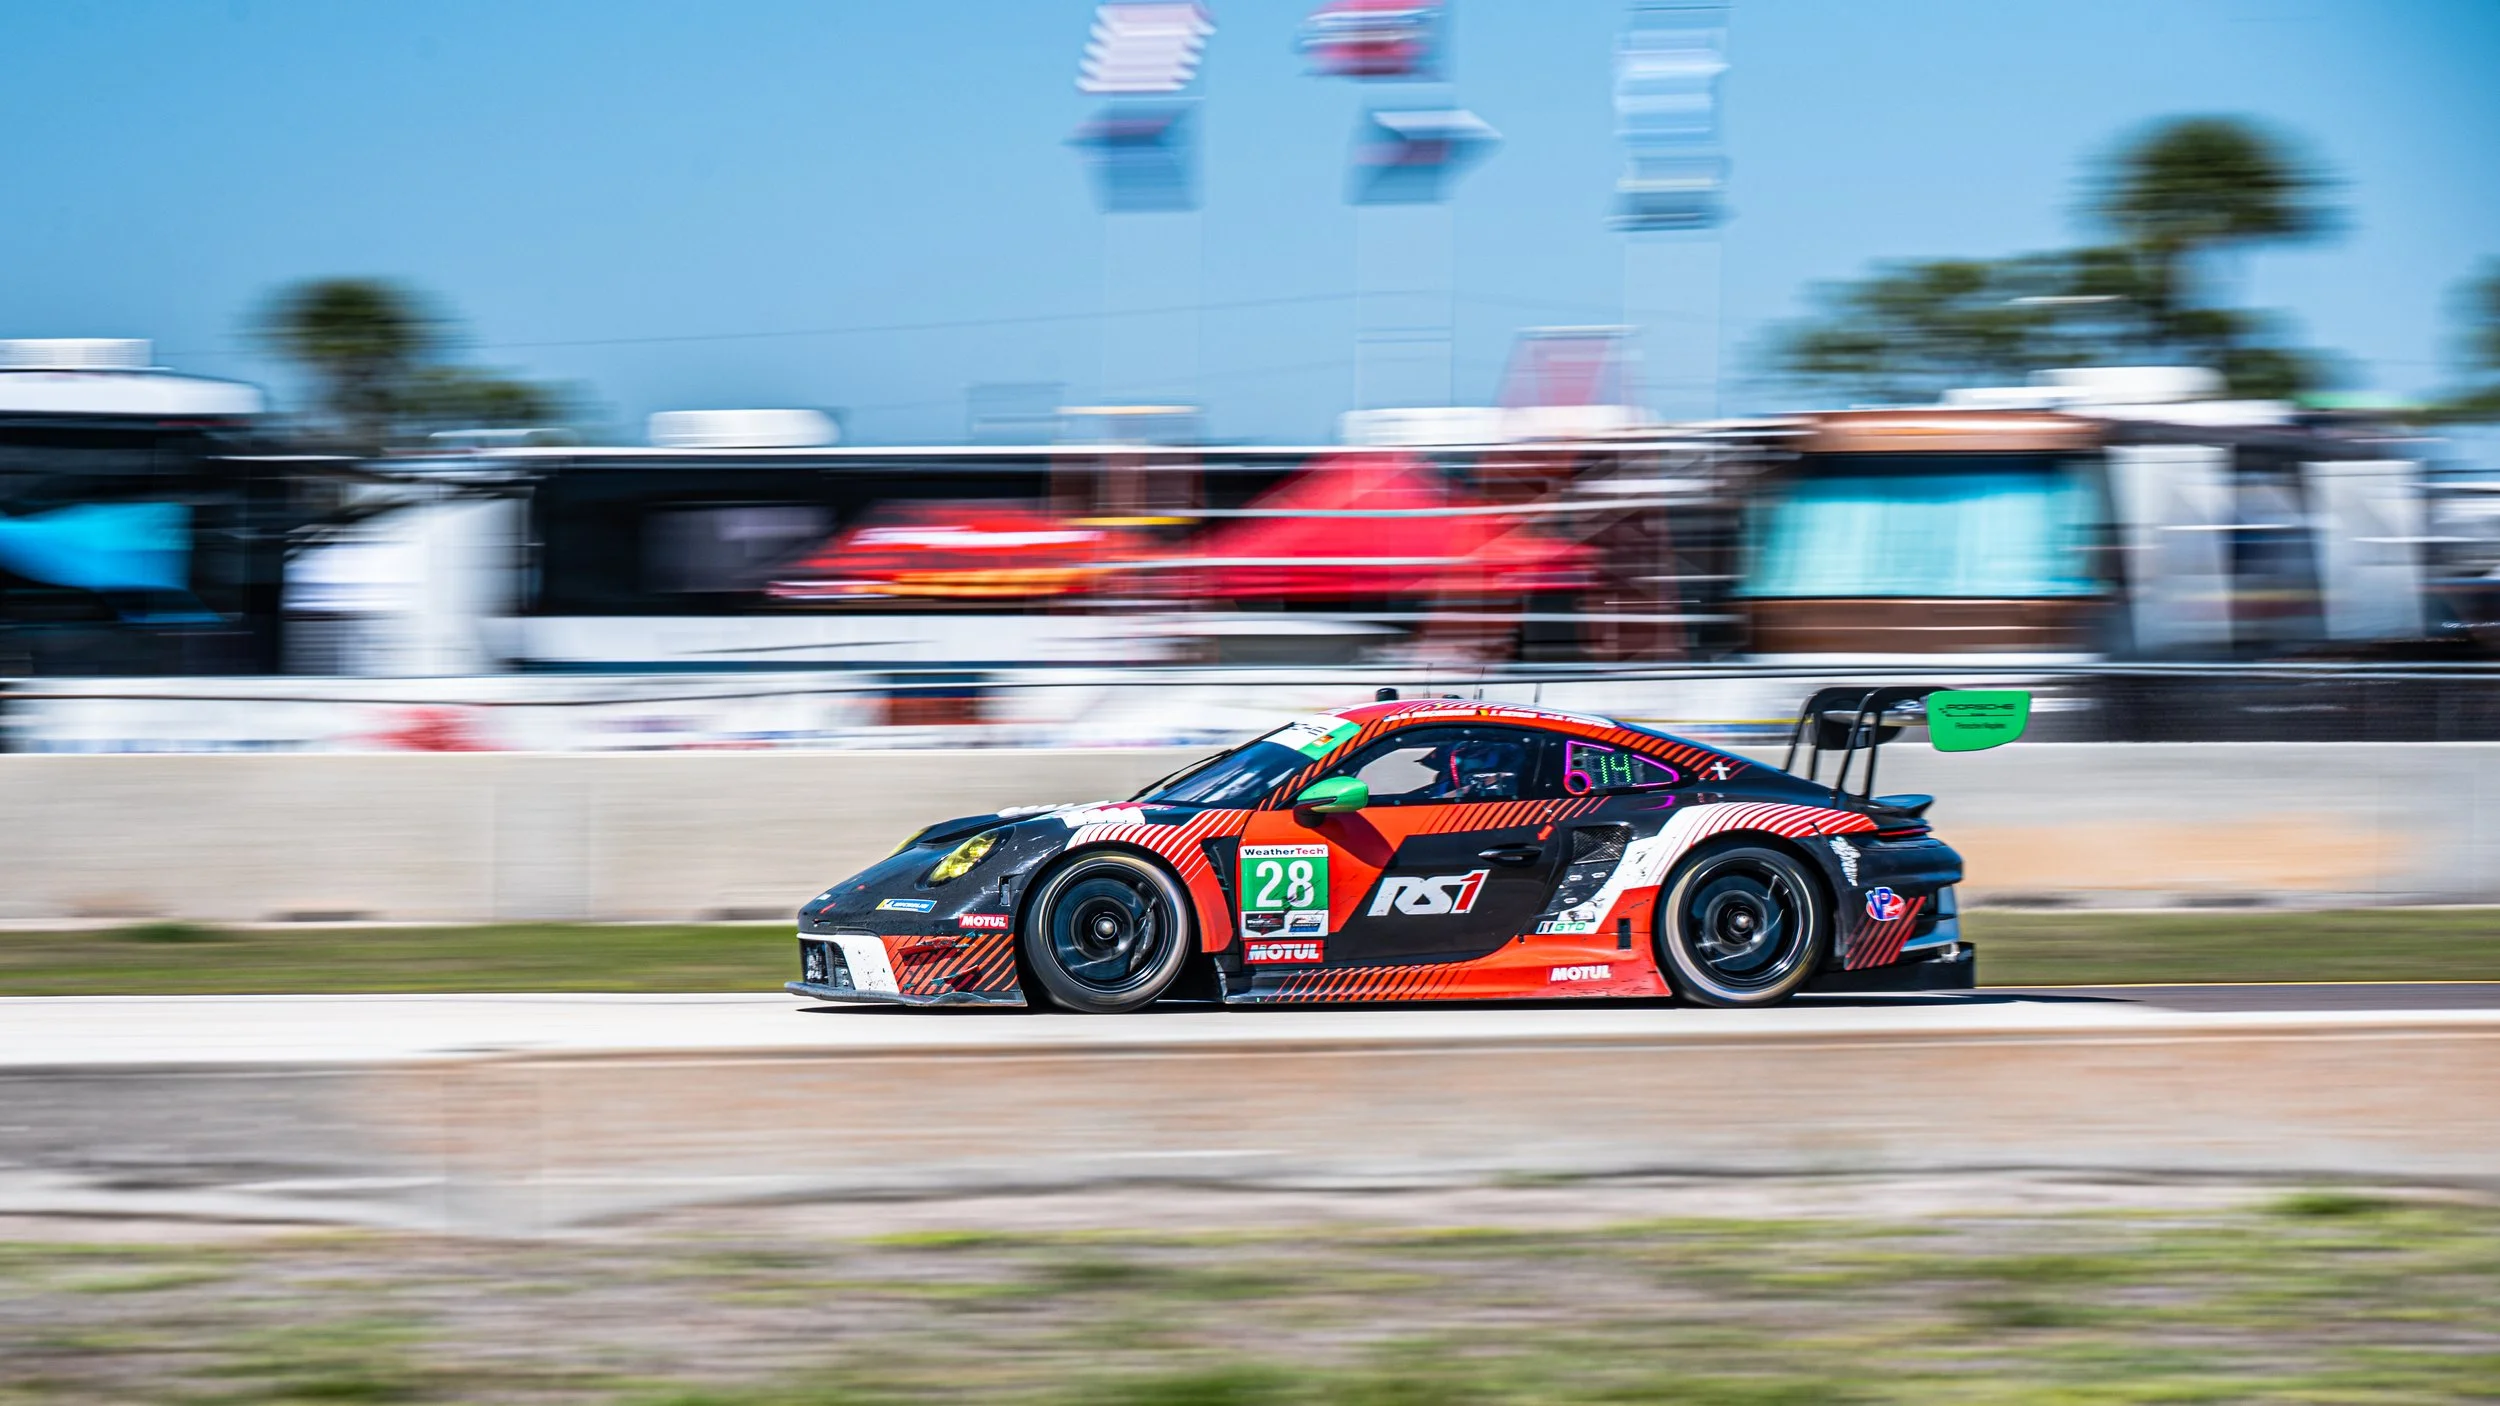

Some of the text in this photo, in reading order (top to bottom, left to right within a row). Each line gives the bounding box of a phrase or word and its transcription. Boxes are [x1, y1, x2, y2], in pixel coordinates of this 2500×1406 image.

[1601, 754, 1631, 784] 14
[1245, 847, 1324, 856] WeatherTech
[1256, 860, 1314, 908] 28
[961, 916, 1005, 927] MOTUL
[1249, 943, 1319, 960] MOTUL
[1551, 965, 1612, 981] MOTUL
